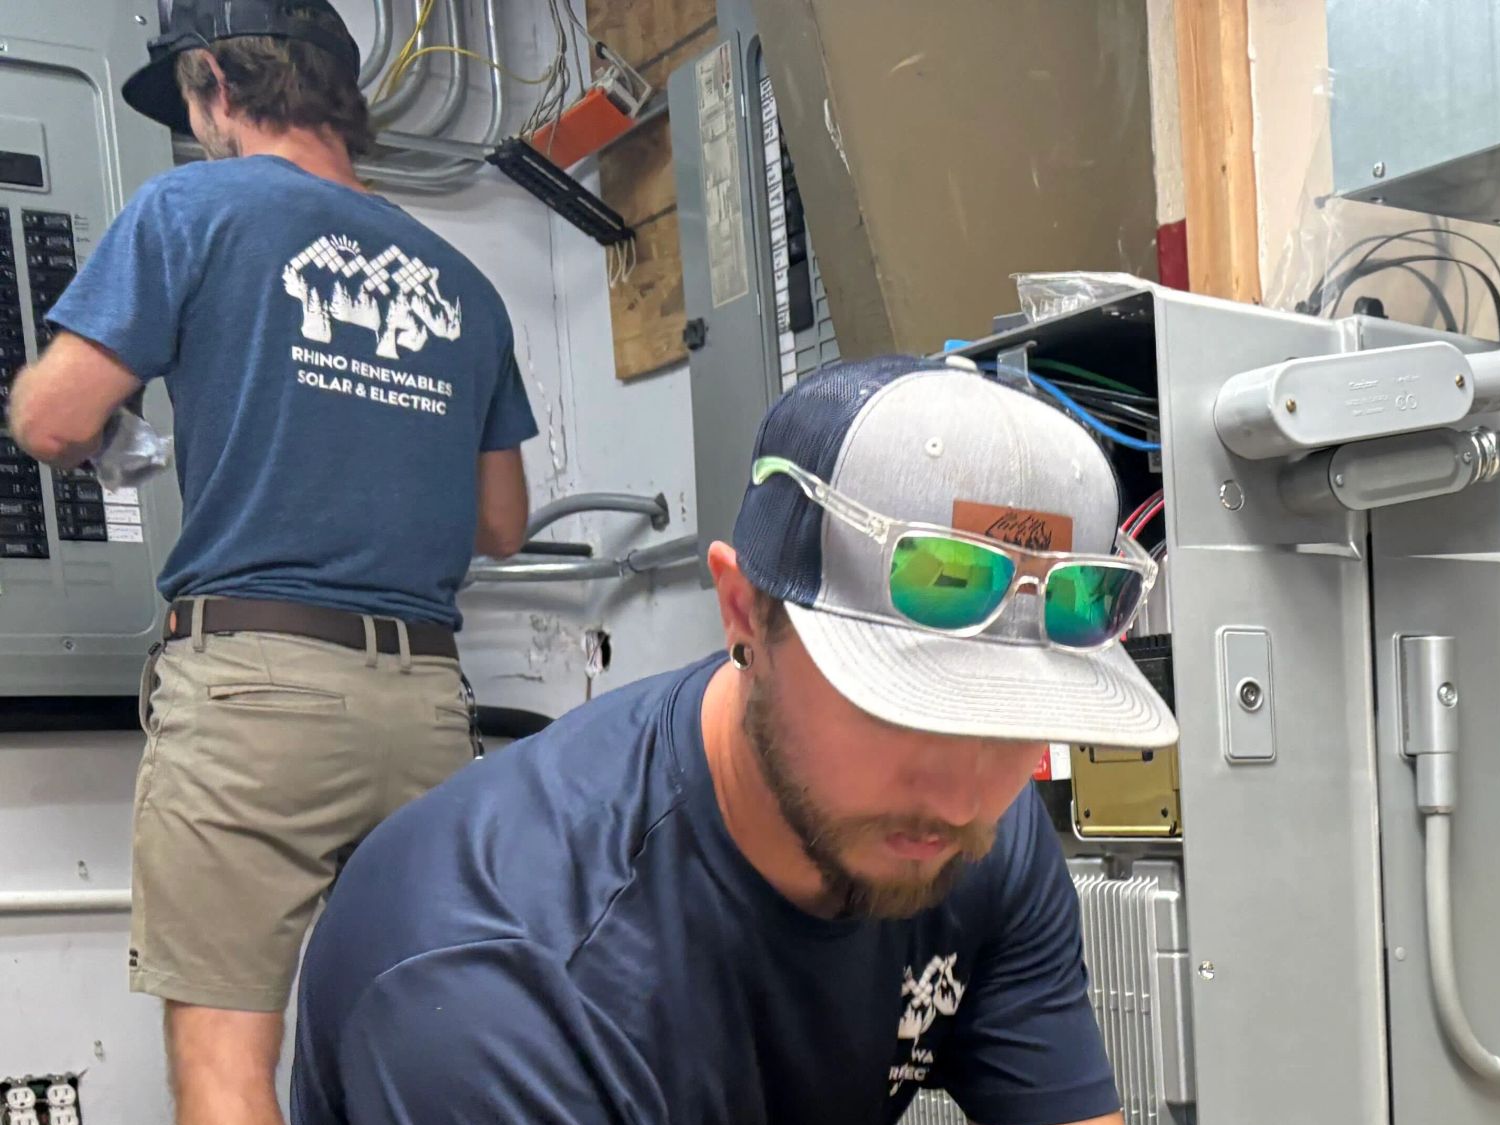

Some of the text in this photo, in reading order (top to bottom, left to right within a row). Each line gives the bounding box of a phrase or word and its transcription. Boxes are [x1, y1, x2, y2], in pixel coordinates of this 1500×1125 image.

[291, 345, 453, 397] RHINO RENEWABLES
[297, 370, 447, 415] SOLAR & ELECTRIC
